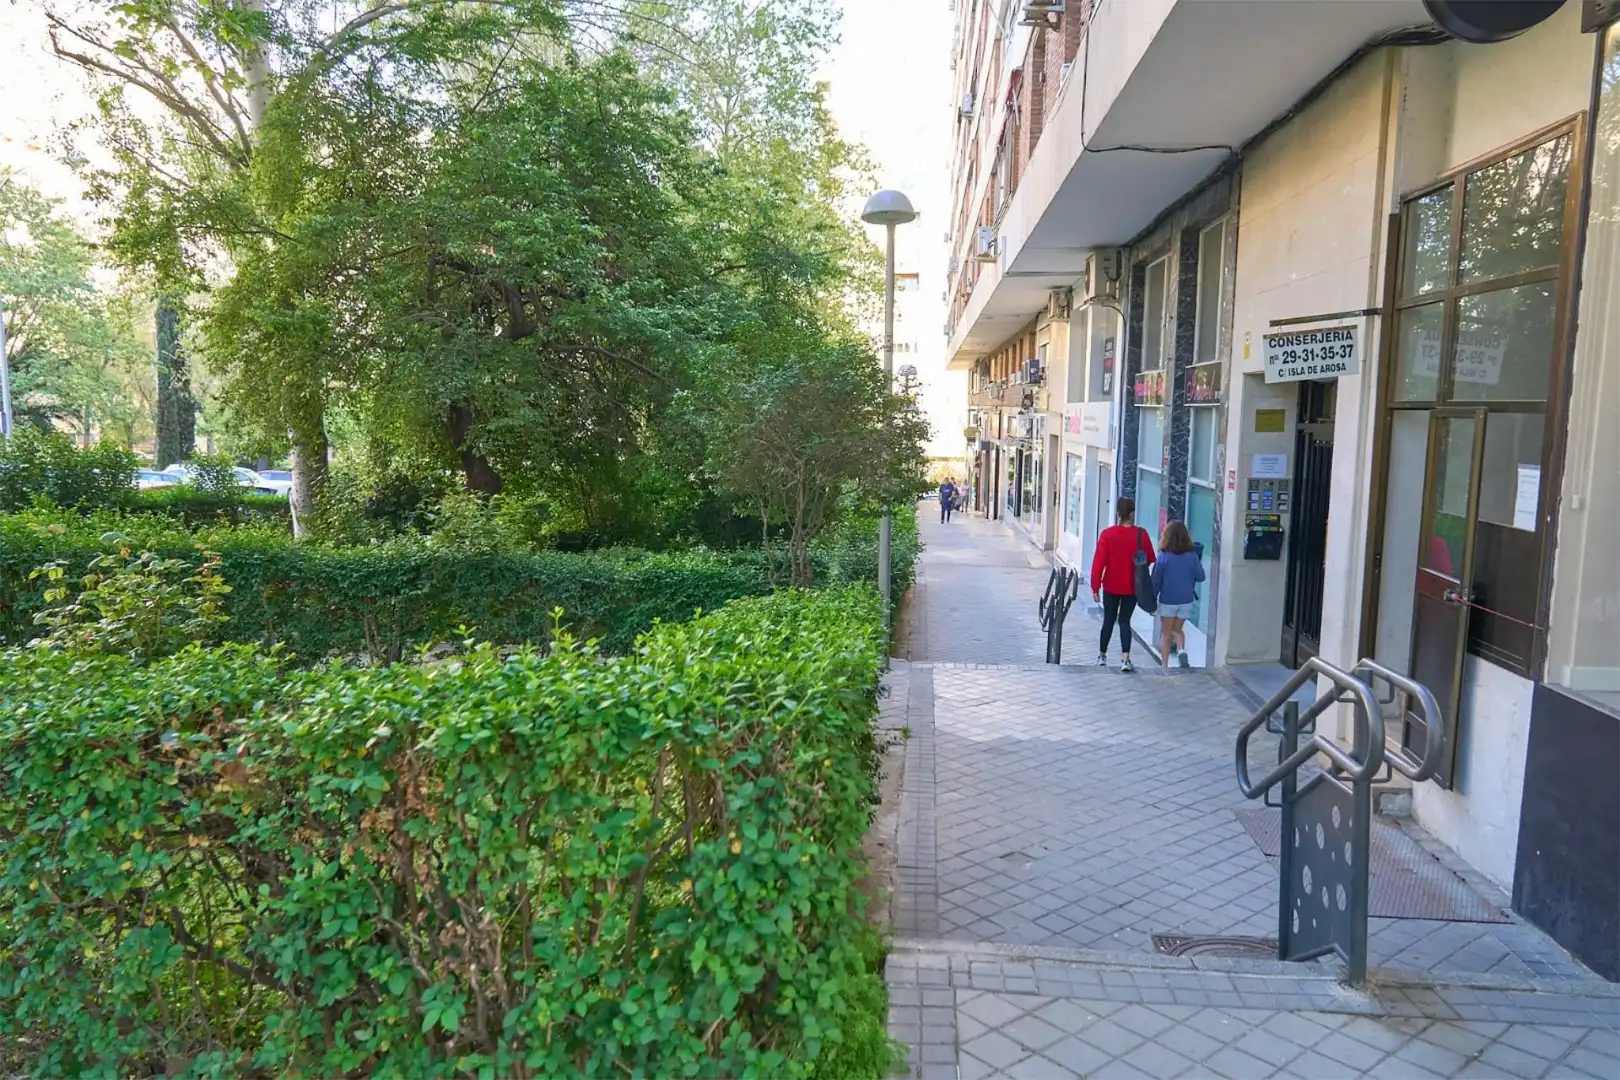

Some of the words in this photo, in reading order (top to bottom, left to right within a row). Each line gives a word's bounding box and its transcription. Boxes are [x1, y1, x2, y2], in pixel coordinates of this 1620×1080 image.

[1288, 366, 1306, 377] ISLA
[1308, 365, 1318, 375] DE
[1320, 362, 1346, 374] AROSA
